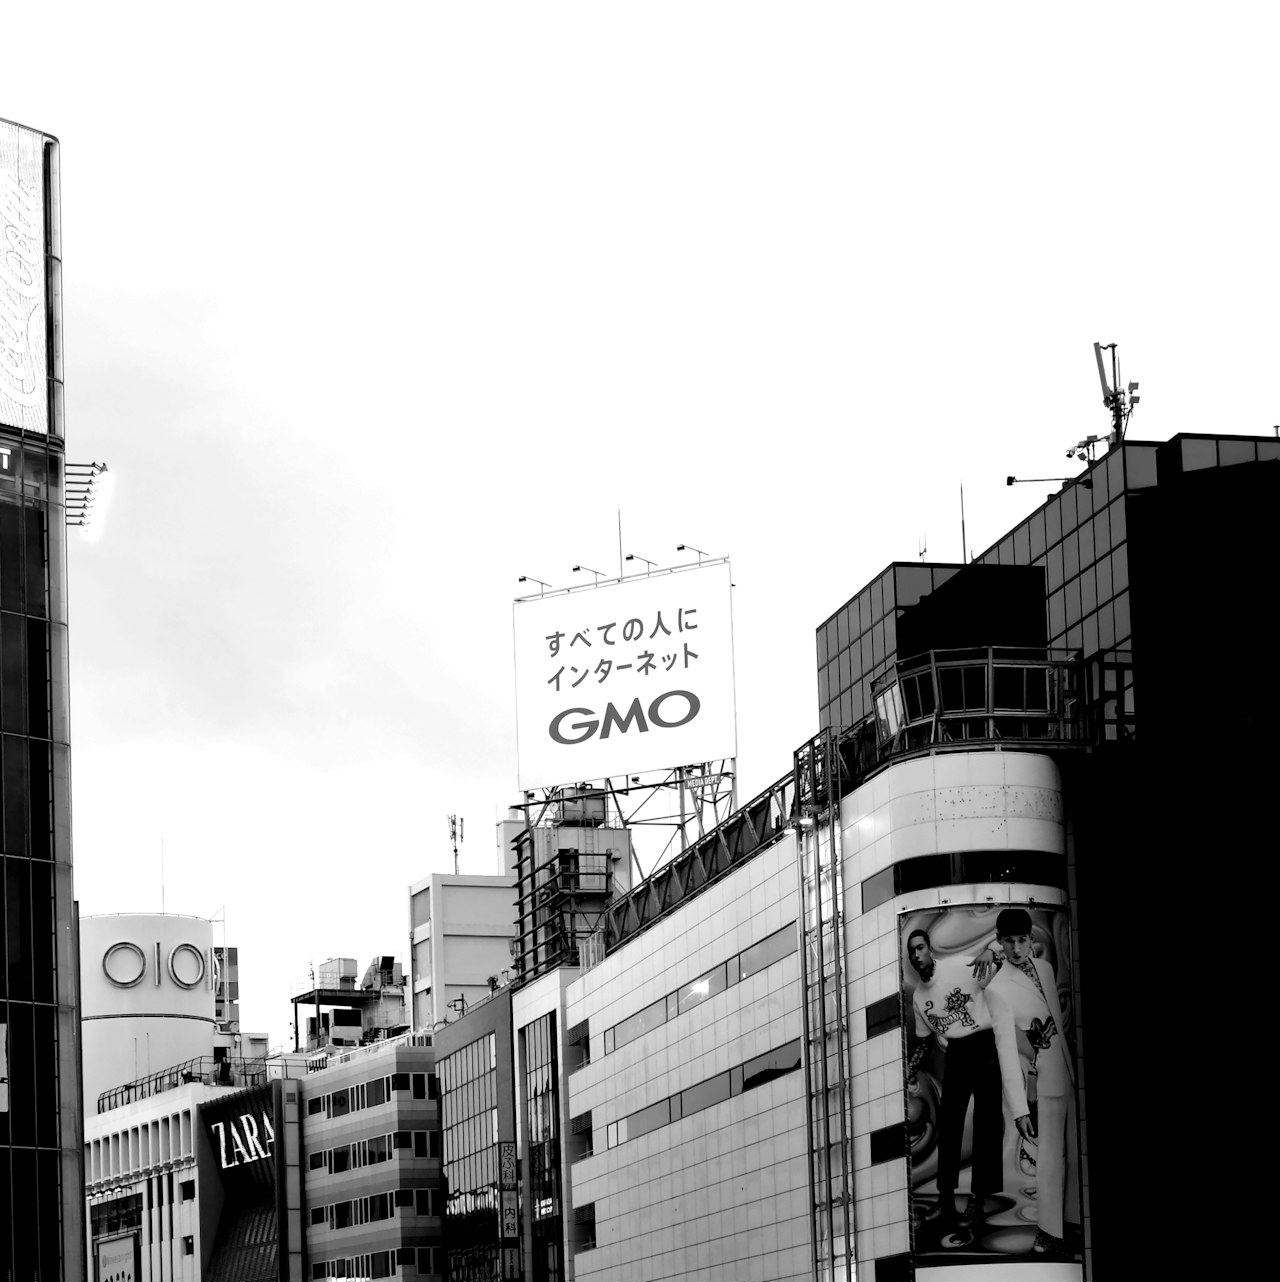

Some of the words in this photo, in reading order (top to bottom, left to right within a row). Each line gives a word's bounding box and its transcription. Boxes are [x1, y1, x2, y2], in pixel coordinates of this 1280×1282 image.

[545, 608, 698, 658] すべての人に
[547, 643, 699, 691] インターネット
[548, 690, 701, 745] GMO
[502, 1144, 515, 1182] 皮ふ科
[504, 1207, 516, 1234] 内科
